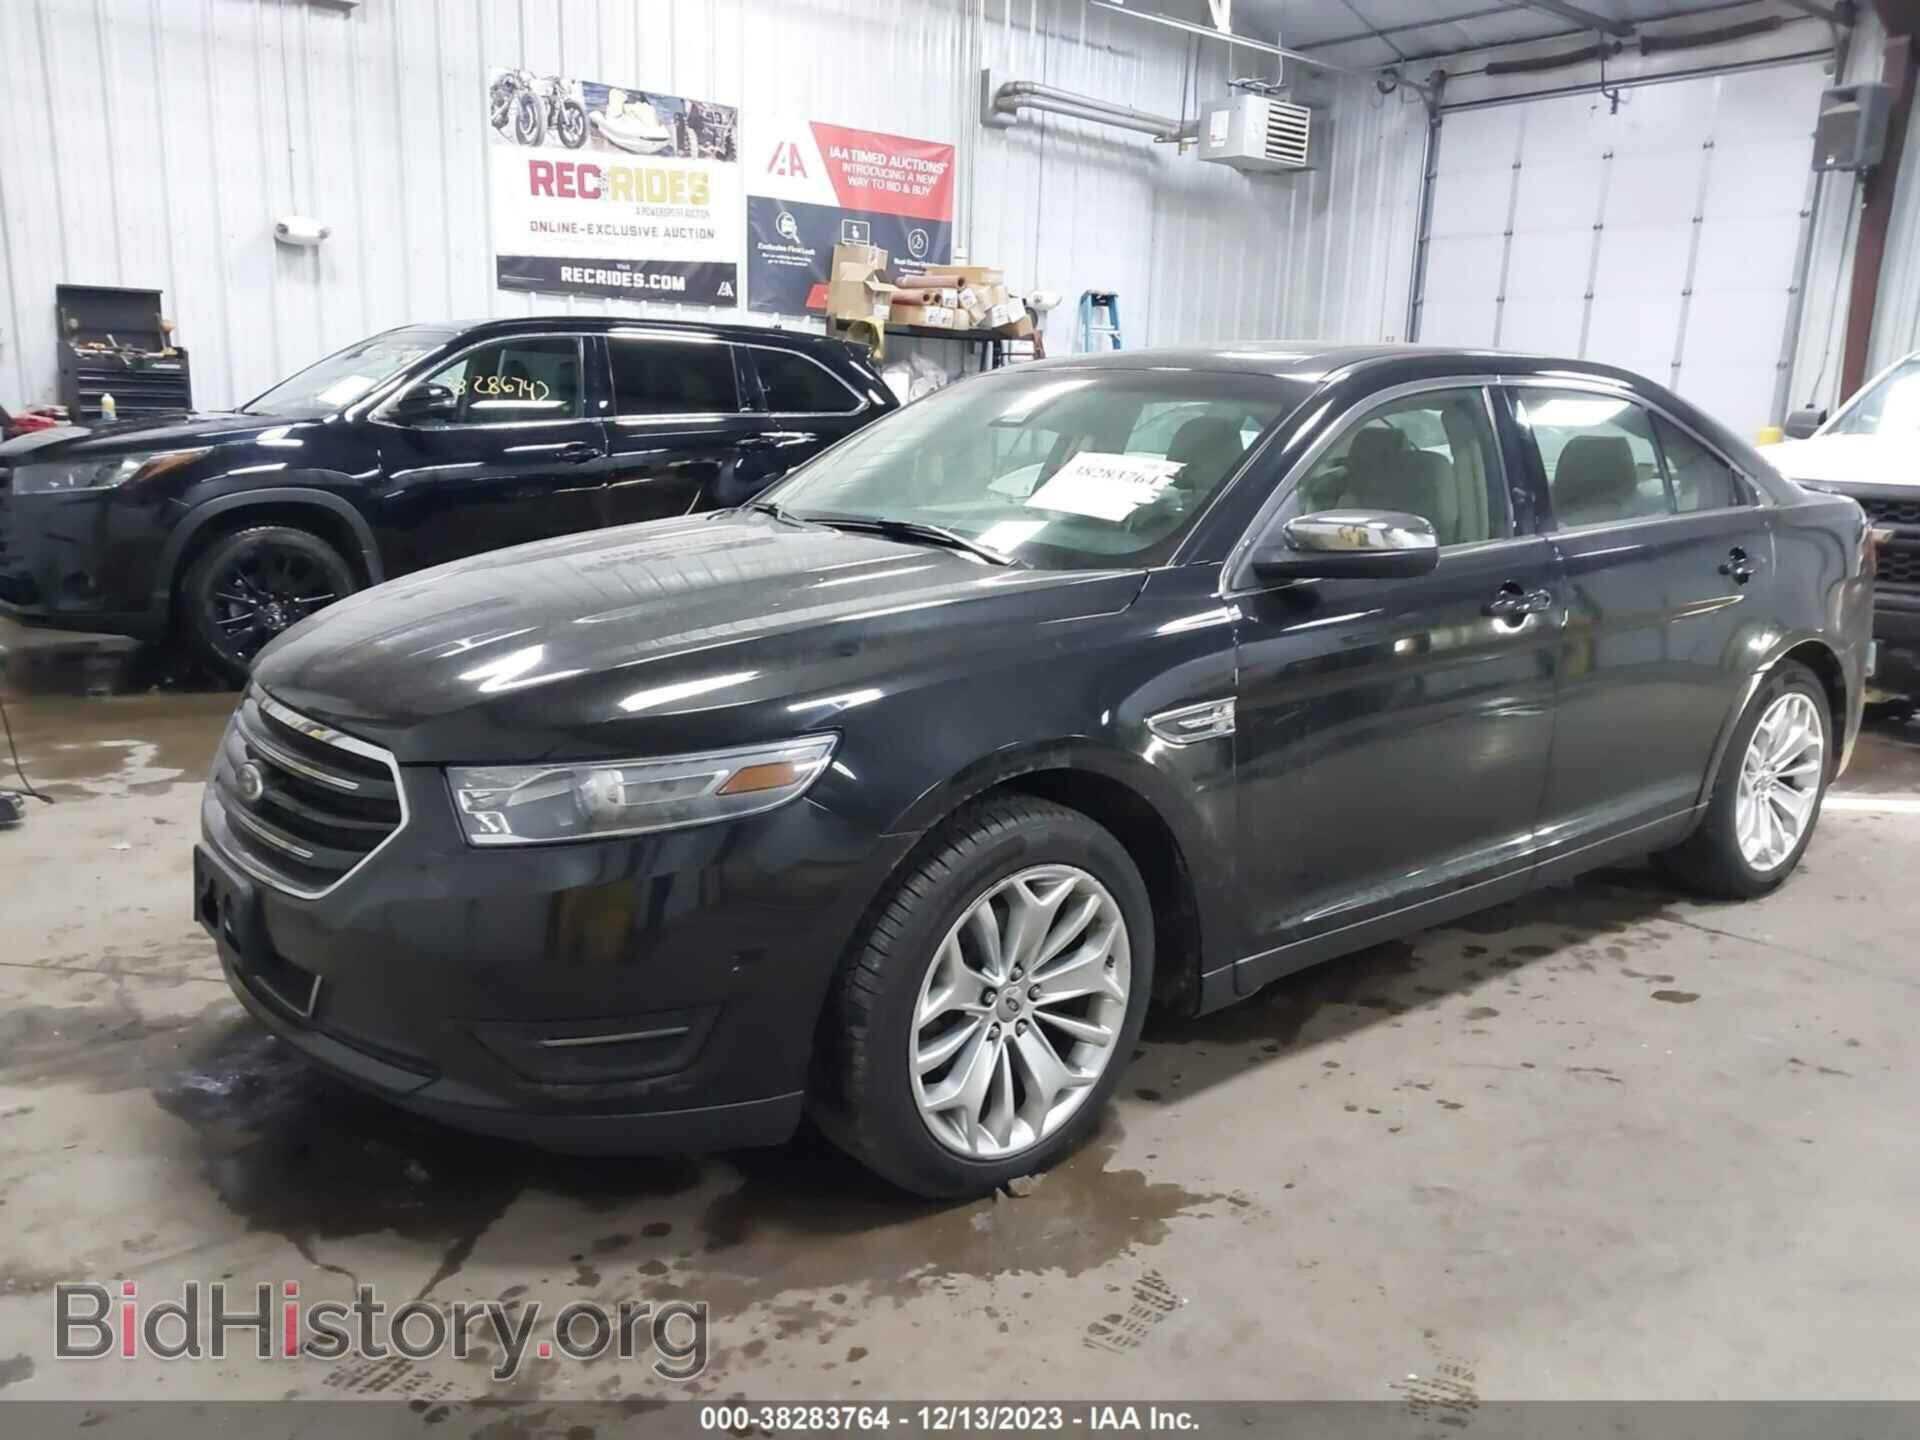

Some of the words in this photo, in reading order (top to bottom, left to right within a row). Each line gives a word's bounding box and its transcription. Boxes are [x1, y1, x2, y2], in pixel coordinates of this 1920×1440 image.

[829, 146, 849, 160] IAA
[849, 150, 886, 165] TIMED
[529, 160, 602, 200] REC
[608, 165, 710, 206] RIDES
[842, 163, 905, 180] INTRODUCING
[907, 173, 914, 183] A
[916, 174, 939, 185] NEW
[848, 176, 869, 188] WAY
[872, 179, 885, 189] TO
[886, 181, 901, 192] BID
[912, 185, 931, 196] BUY
[530, 220, 659, 238] ONLINE-EXCLUSIVE
[663, 228, 715, 240] AUCTION
[560, 266, 686, 291] RECRIDES.COM
